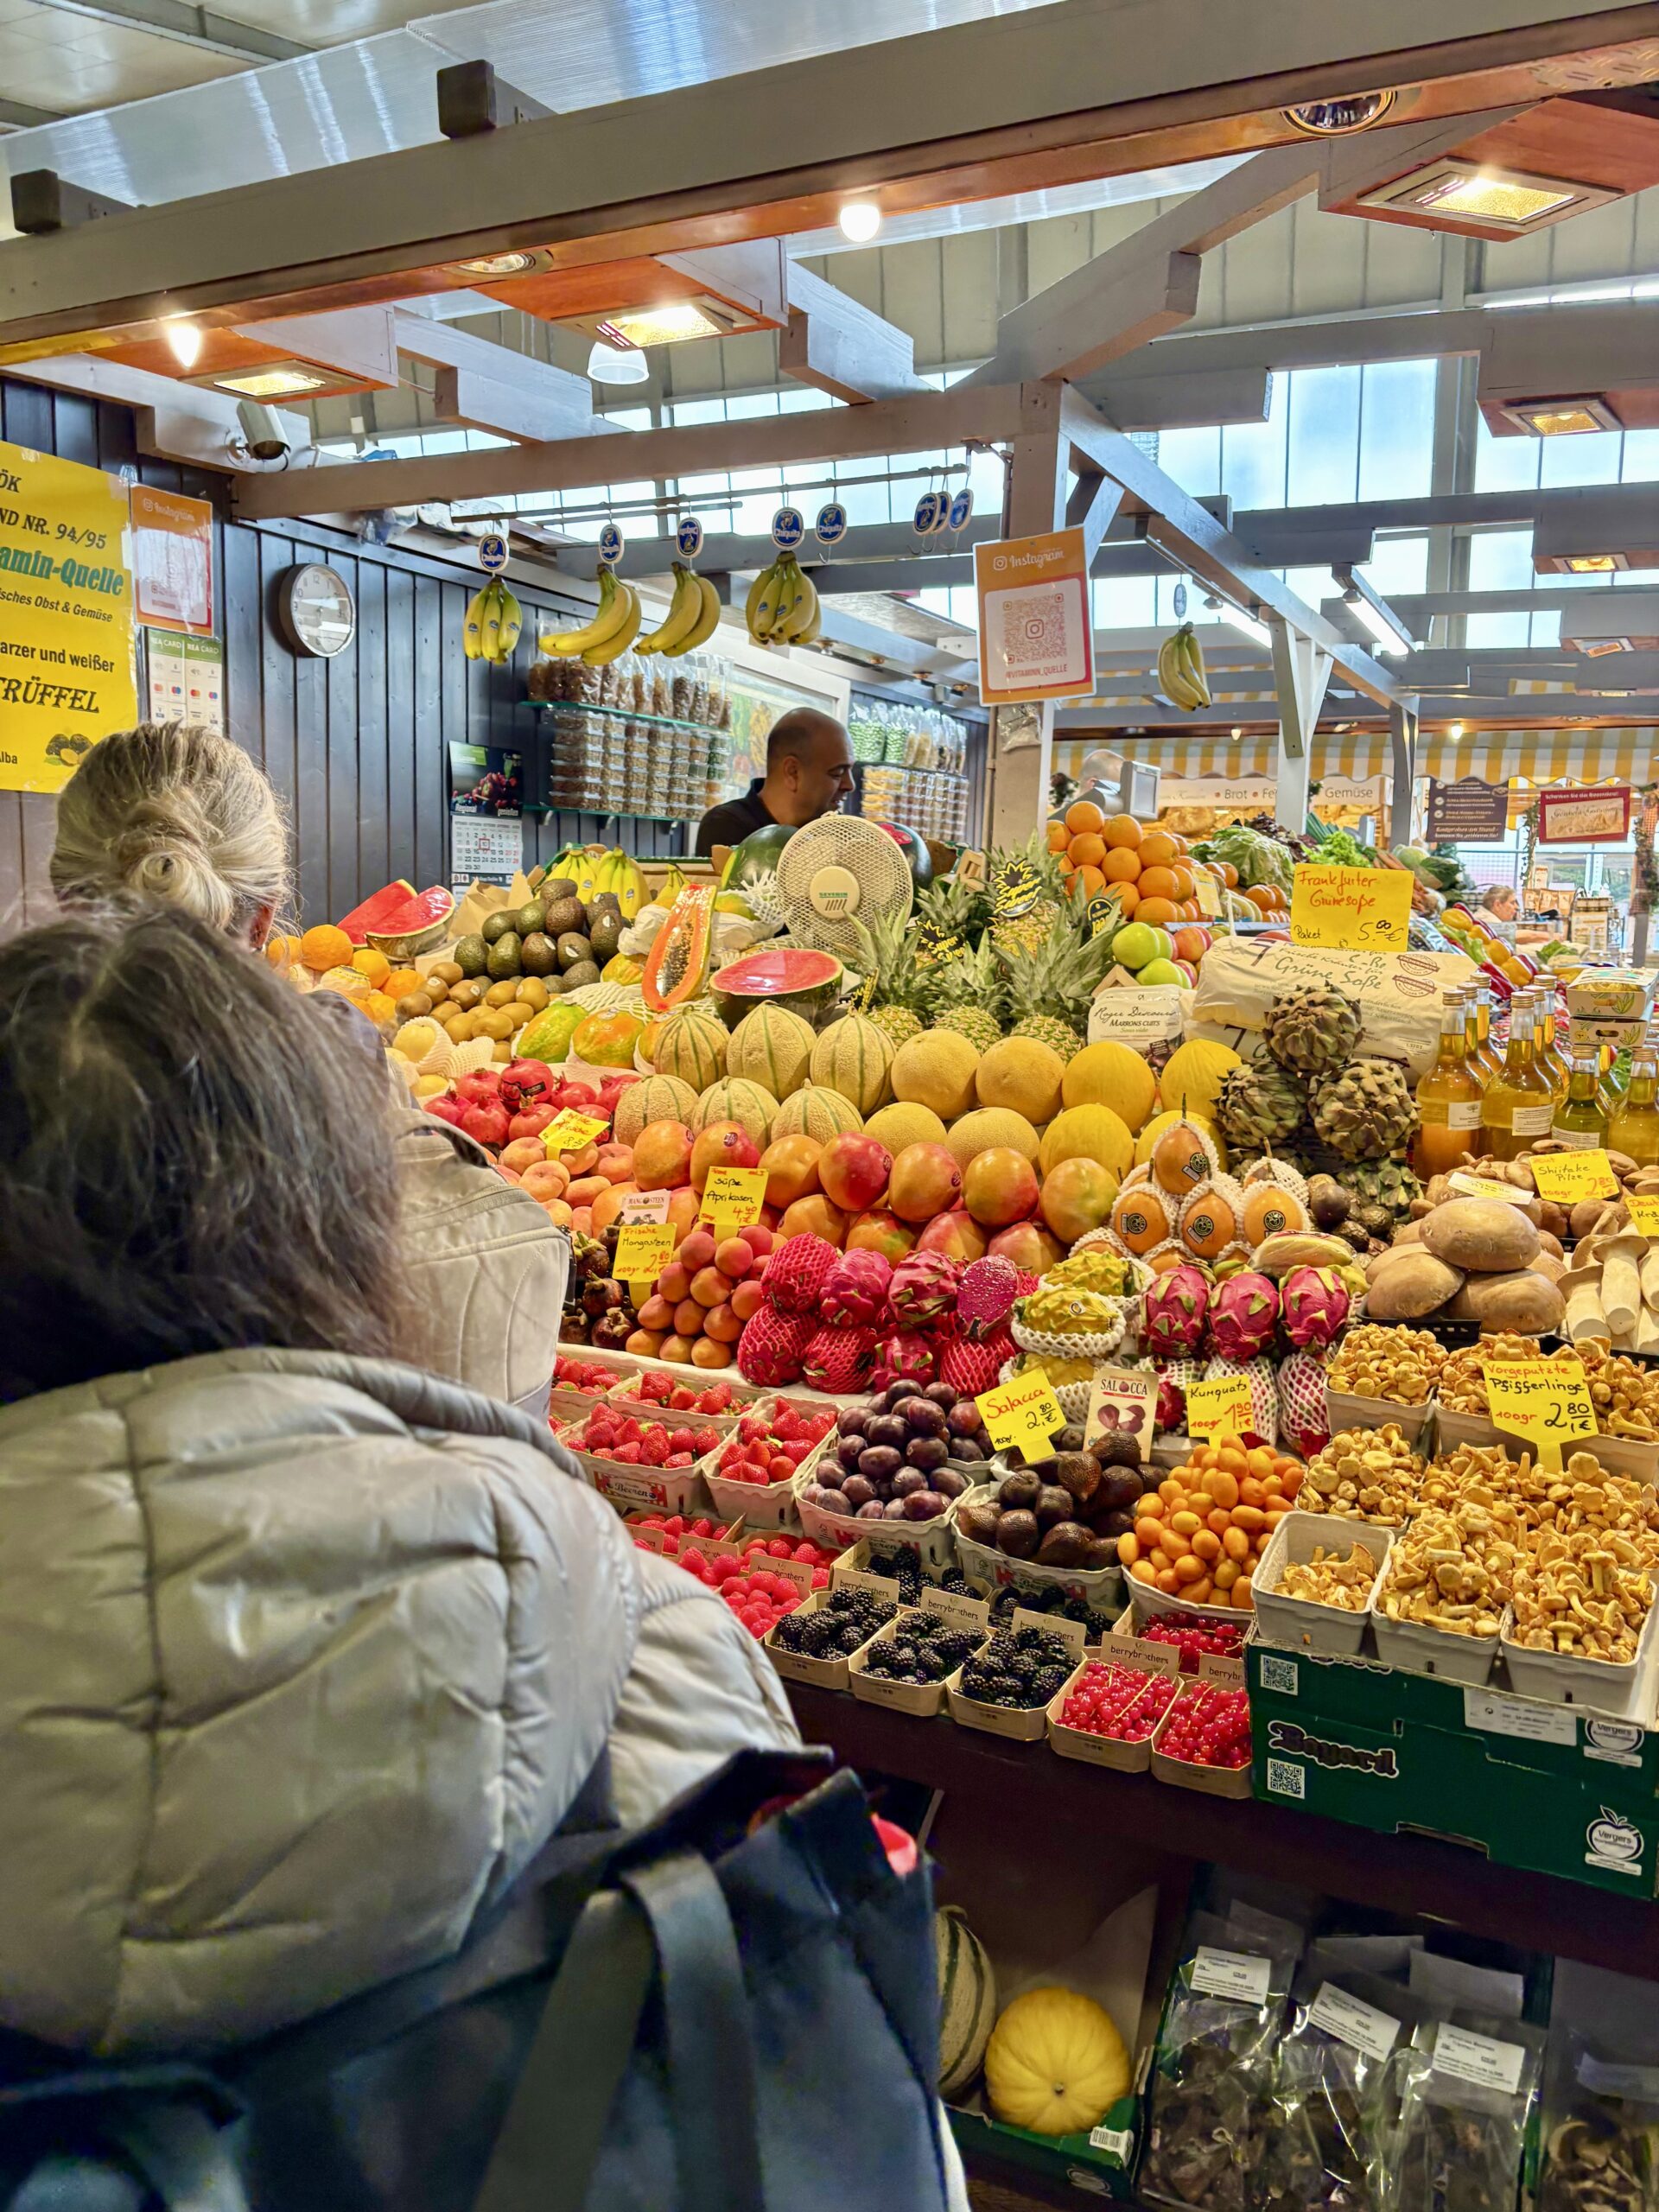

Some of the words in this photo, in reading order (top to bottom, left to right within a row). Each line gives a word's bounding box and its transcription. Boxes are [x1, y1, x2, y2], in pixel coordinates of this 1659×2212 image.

[22, 514, 50, 536] NR.
[54, 523, 107, 550] 94/95
[773, 528, 801, 539] Chiquita
[1009, 548, 1065, 569] Instagram
[35, 595, 60, 612] Obst
[61, 601, 71, 613] &
[73, 604, 114, 623] Gemüse
[1, 641, 36, 660] arzer
[40, 648, 67, 665] und
[69, 654, 115, 674] weißer
[0, 750, 18, 765] lba
[1224, 788, 1248, 800] Brot
[1325, 785, 1374, 799] Gemüse
[995, 877, 1042, 900] Super
[993, 886, 1043, 914] Sweet
[1294, 925, 1321, 939] Paket
[1274, 957, 1332, 980] Grüne
[1339, 970, 1382, 993] Soße
[1109, 1019, 1142, 1027] MARRONS
[1538, 1163, 1591, 1175] Shiitake
[1555, 1173, 1584, 1182] Pilze
[706, 1190, 754, 1205] Aprikosen
[622, 1236, 671, 1251] Mangosteen
[1487, 1362, 1572, 1379] Vorgeputzte
[1190, 1378, 1248, 1402] Kumquats
[1489, 1377, 1586, 1395] Pfifferlinge
[986, 1388, 1046, 1420] Salacca
[1190, 1419, 1223, 1431] 100gr
[1495, 1410, 1538, 1425] 100gr
[613, 1482, 650, 1497] Beeren
[928, 1599, 979, 1621] berrybrothers
[1110, 1644, 1169, 1665] berrybrothers
[1599, 1830, 1633, 1844] Vergers
